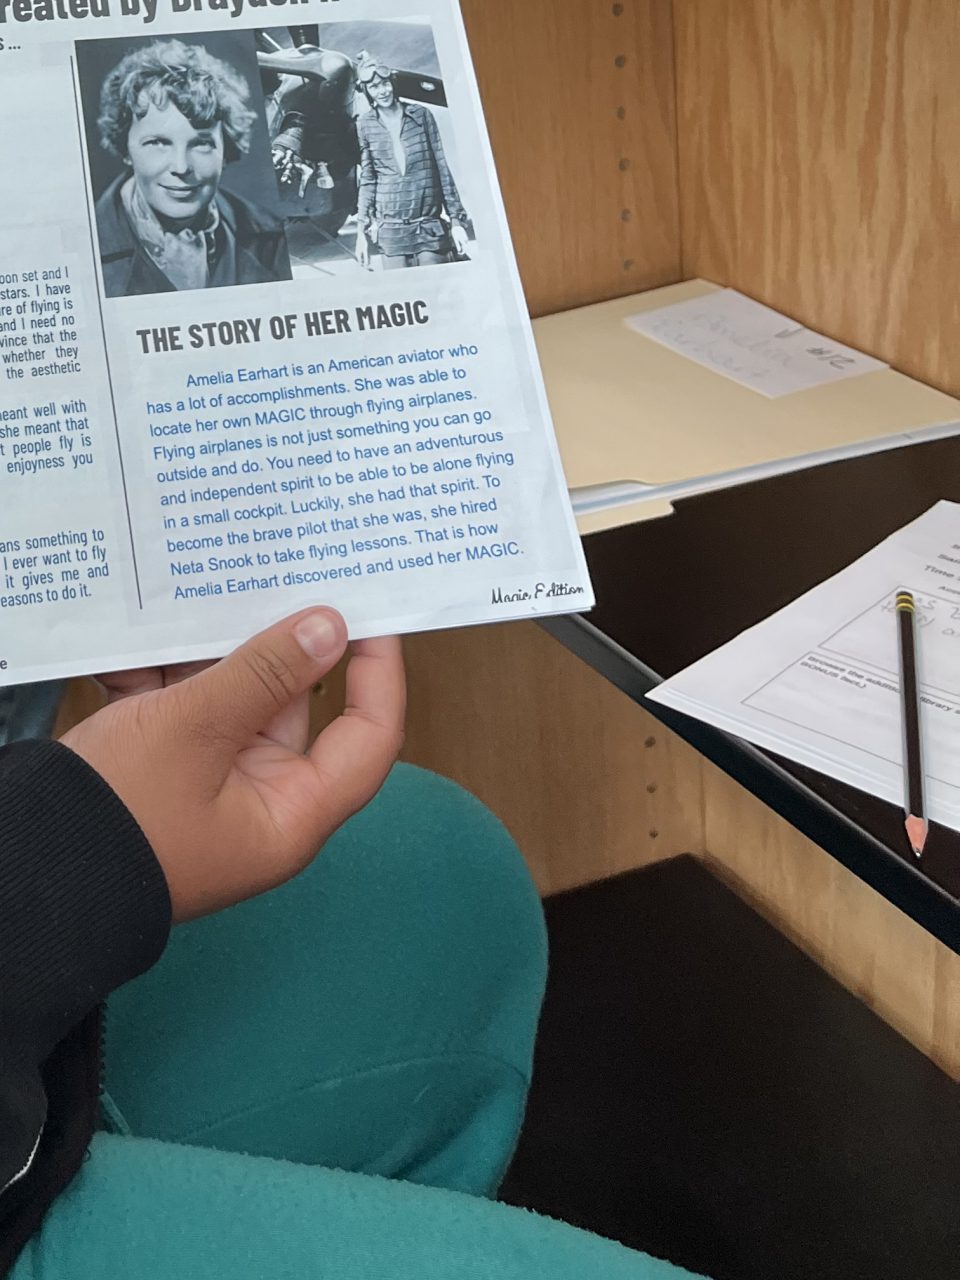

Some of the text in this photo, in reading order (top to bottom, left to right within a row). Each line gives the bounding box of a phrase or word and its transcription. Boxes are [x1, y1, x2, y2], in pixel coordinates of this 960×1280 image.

[0, 288, 30, 300] stars.
[36, 284, 40, 297] I
[45, 283, 71, 296] have
[22, 270, 39, 282] set
[42, 267, 62, 280] and
[65, 266, 69, 278] I
[136, 300, 429, 354] THE STORY OF HER MAGIC
[187, 344, 478, 388] Amelia Earhart is an American aviator who
[33, 402, 56, 417] well
[61, 399, 87, 414] with
[146, 368, 466, 415] has a lot of accomplishments. She was able to
[150, 390, 477, 437] locate her own MAGIC through flying airplanes.
[0, 424, 20, 439] she
[24, 420, 61, 436] meant
[65, 417, 89, 436] that
[153, 410, 491, 462] Flying airplanes is not just something you can go
[157, 431, 504, 483] outside and do. You need to have an adventurous
[160, 452, 514, 506] and independent spirit to be able to be alone flying
[163, 475, 501, 529] in a small cockpit. Luckily, she had that spirit. To
[25, 530, 88, 550] something
[92, 529, 104, 541] to
